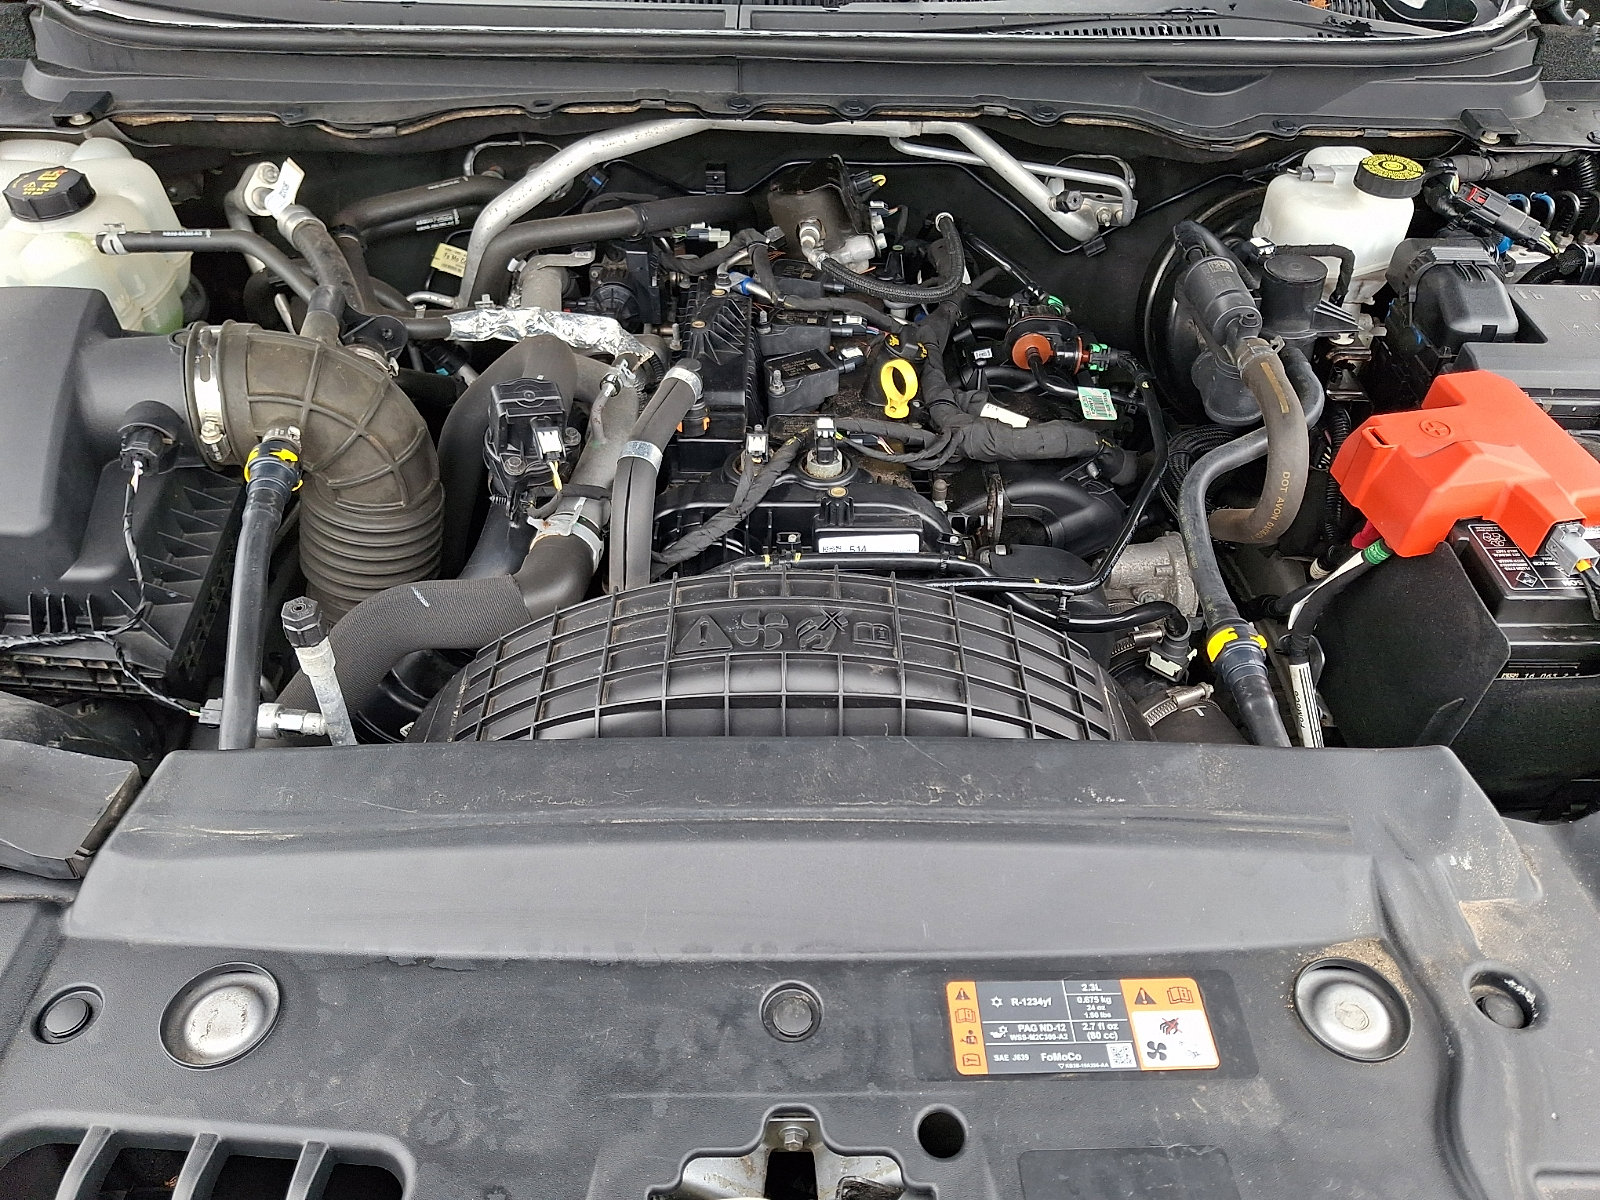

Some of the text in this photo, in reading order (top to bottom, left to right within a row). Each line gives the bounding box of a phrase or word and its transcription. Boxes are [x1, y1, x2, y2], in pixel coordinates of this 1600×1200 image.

[1270, 471, 1291, 521] DOT AVON
[1081, 983, 1102, 992] 2.3L
[1010, 997, 1052, 1008] R-1234yf
[1100, 996, 1112, 1005] kg
[1017, 1024, 1067, 1033] PAG ND-12
[1082, 1023, 1096, 1031] 2.7
[1103, 1032, 1118, 1041] cc)
[993, 1053, 1030, 1062] SAE J639
[1040, 1051, 1082, 1063] FoMoCo
